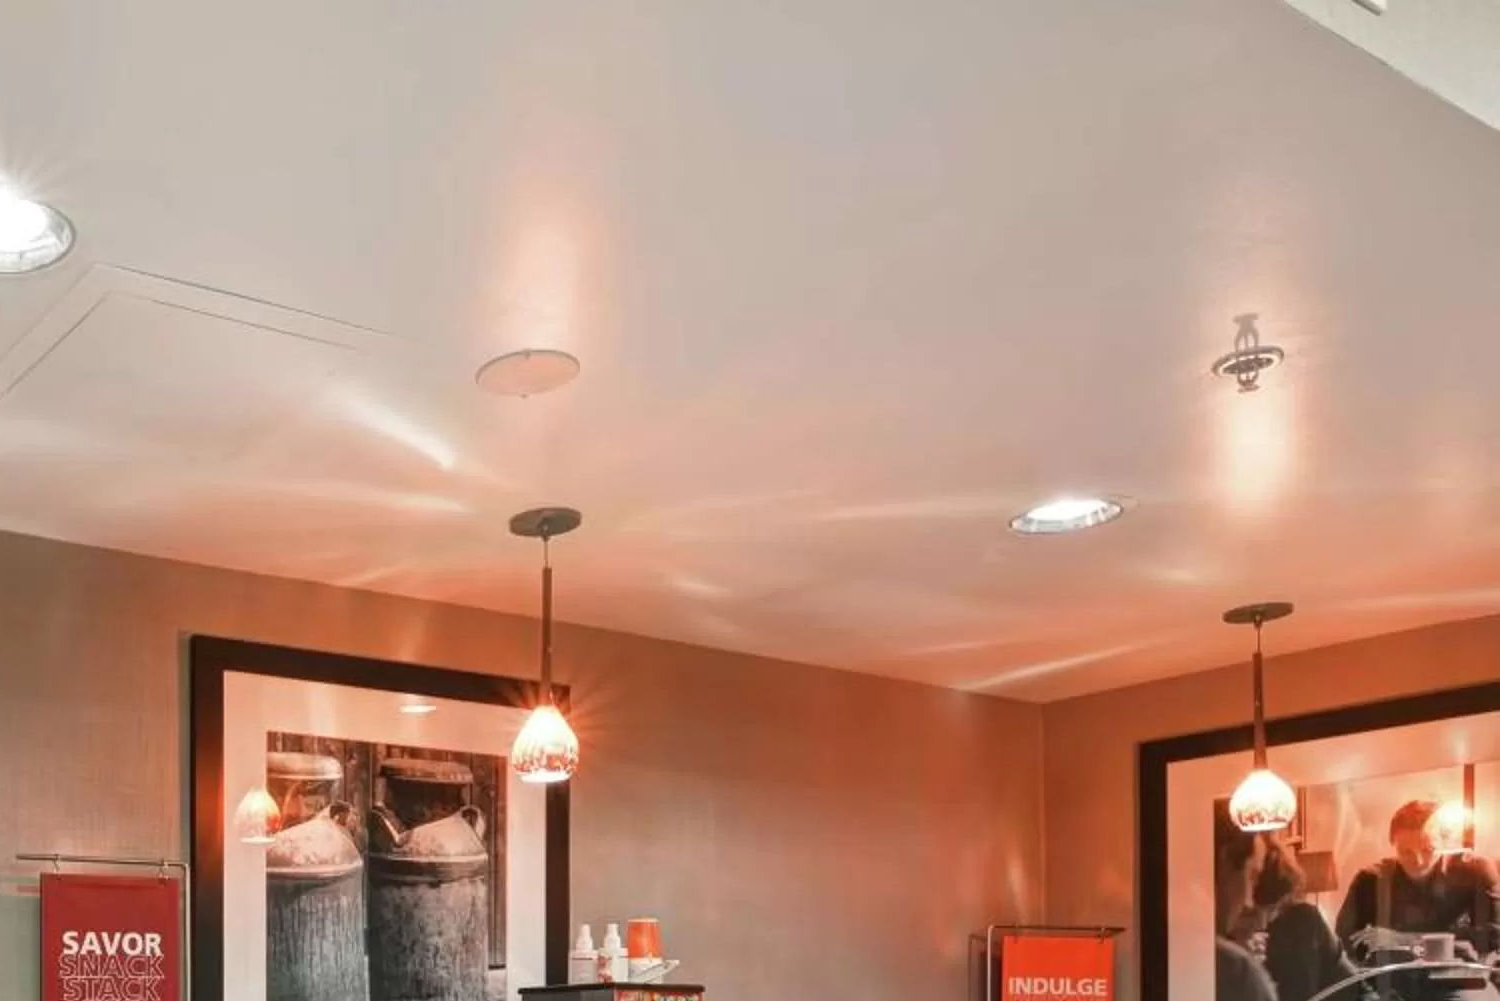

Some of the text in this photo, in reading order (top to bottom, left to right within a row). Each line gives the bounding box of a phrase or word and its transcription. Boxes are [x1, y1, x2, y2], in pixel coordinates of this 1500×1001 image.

[62, 931, 161, 955] SAVOR
[59, 953, 165, 979] SNACK
[63, 976, 161, 1001] STACK
[1008, 976, 1108, 996] INDULGE
